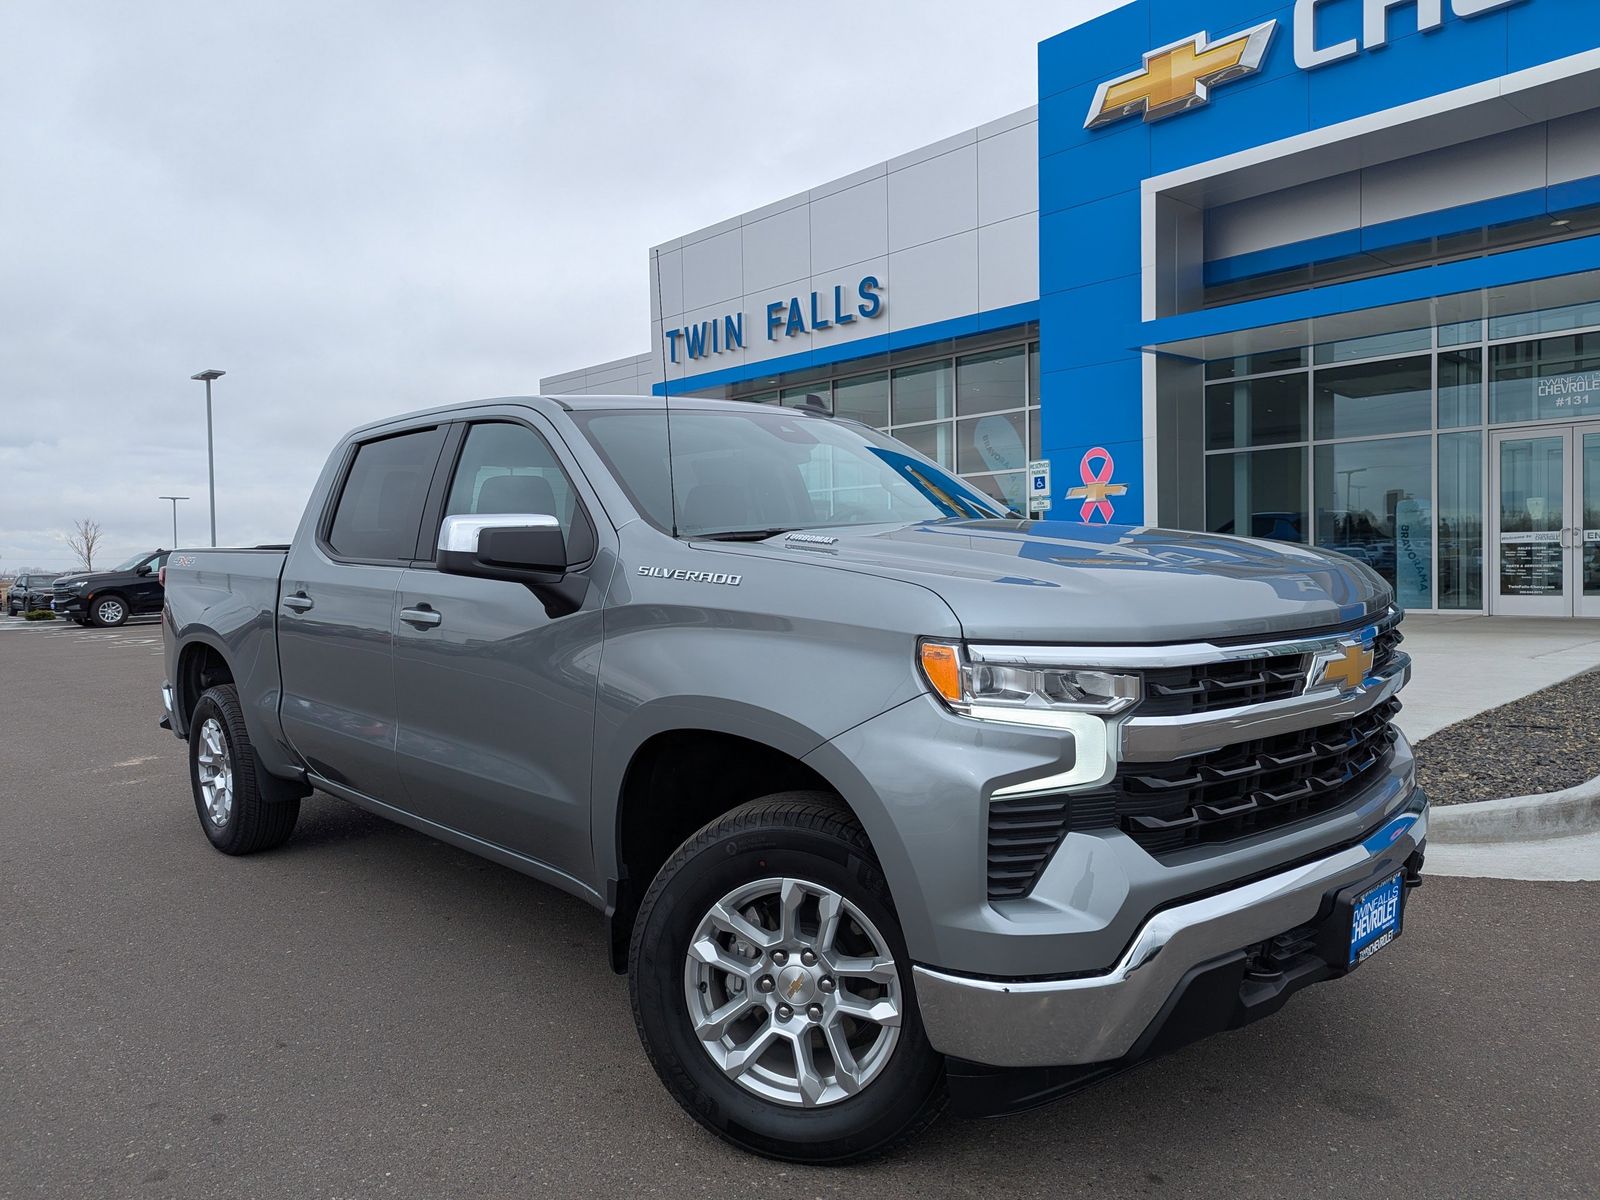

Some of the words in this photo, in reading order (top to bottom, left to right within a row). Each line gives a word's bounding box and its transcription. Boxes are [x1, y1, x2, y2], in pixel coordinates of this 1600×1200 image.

[1293, 0, 1513, 69] CH
[665, 312, 747, 364] TWIN
[766, 275, 884, 341] FALLS
[1555, 394, 1589, 407] #131
[637, 565, 743, 586] SILVERADO
[1400, 524, 1428, 592] BRAVORAMA
[1351, 897, 1398, 944] CHEVROLET
[1353, 885, 1399, 923] TWINFALLS
